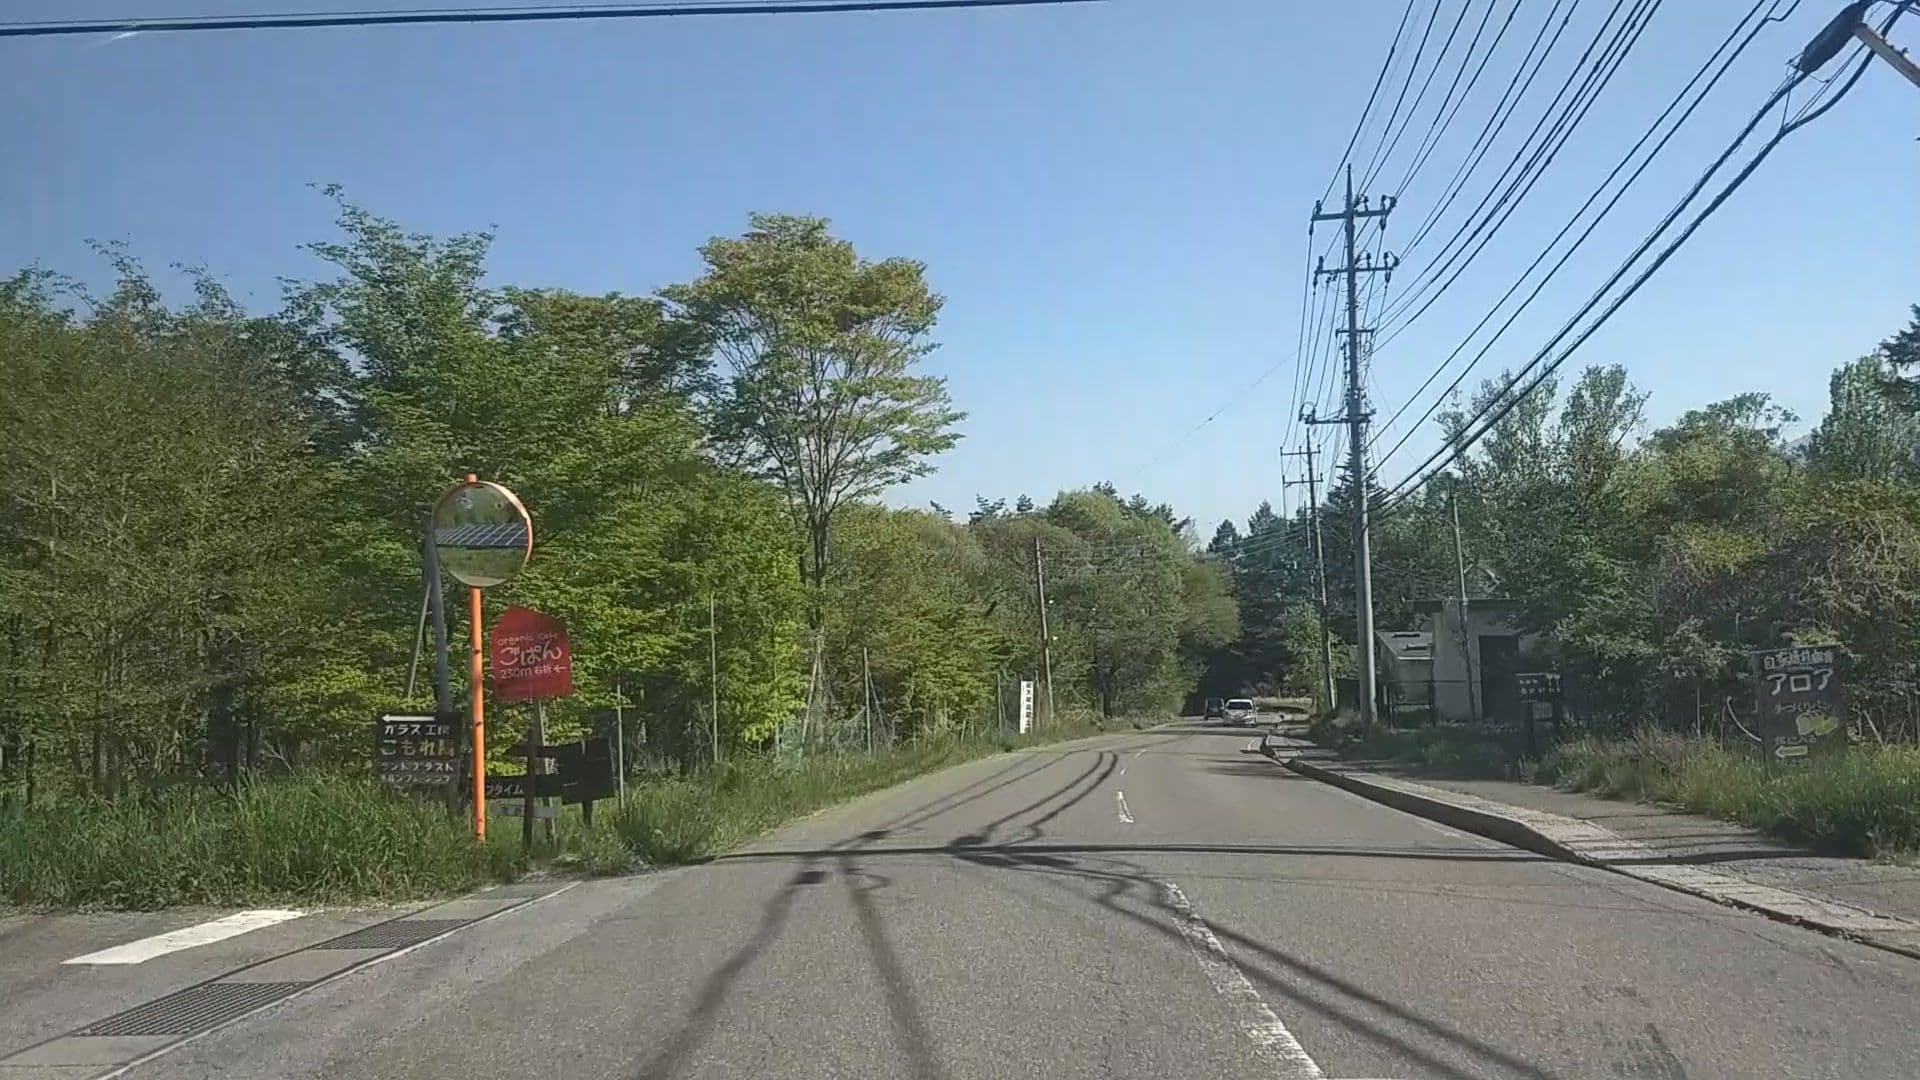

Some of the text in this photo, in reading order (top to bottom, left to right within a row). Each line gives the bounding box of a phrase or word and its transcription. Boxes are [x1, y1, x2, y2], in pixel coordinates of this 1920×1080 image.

[499, 640, 562, 667] ごぱん
[1766, 668, 1834, 696] アロア
